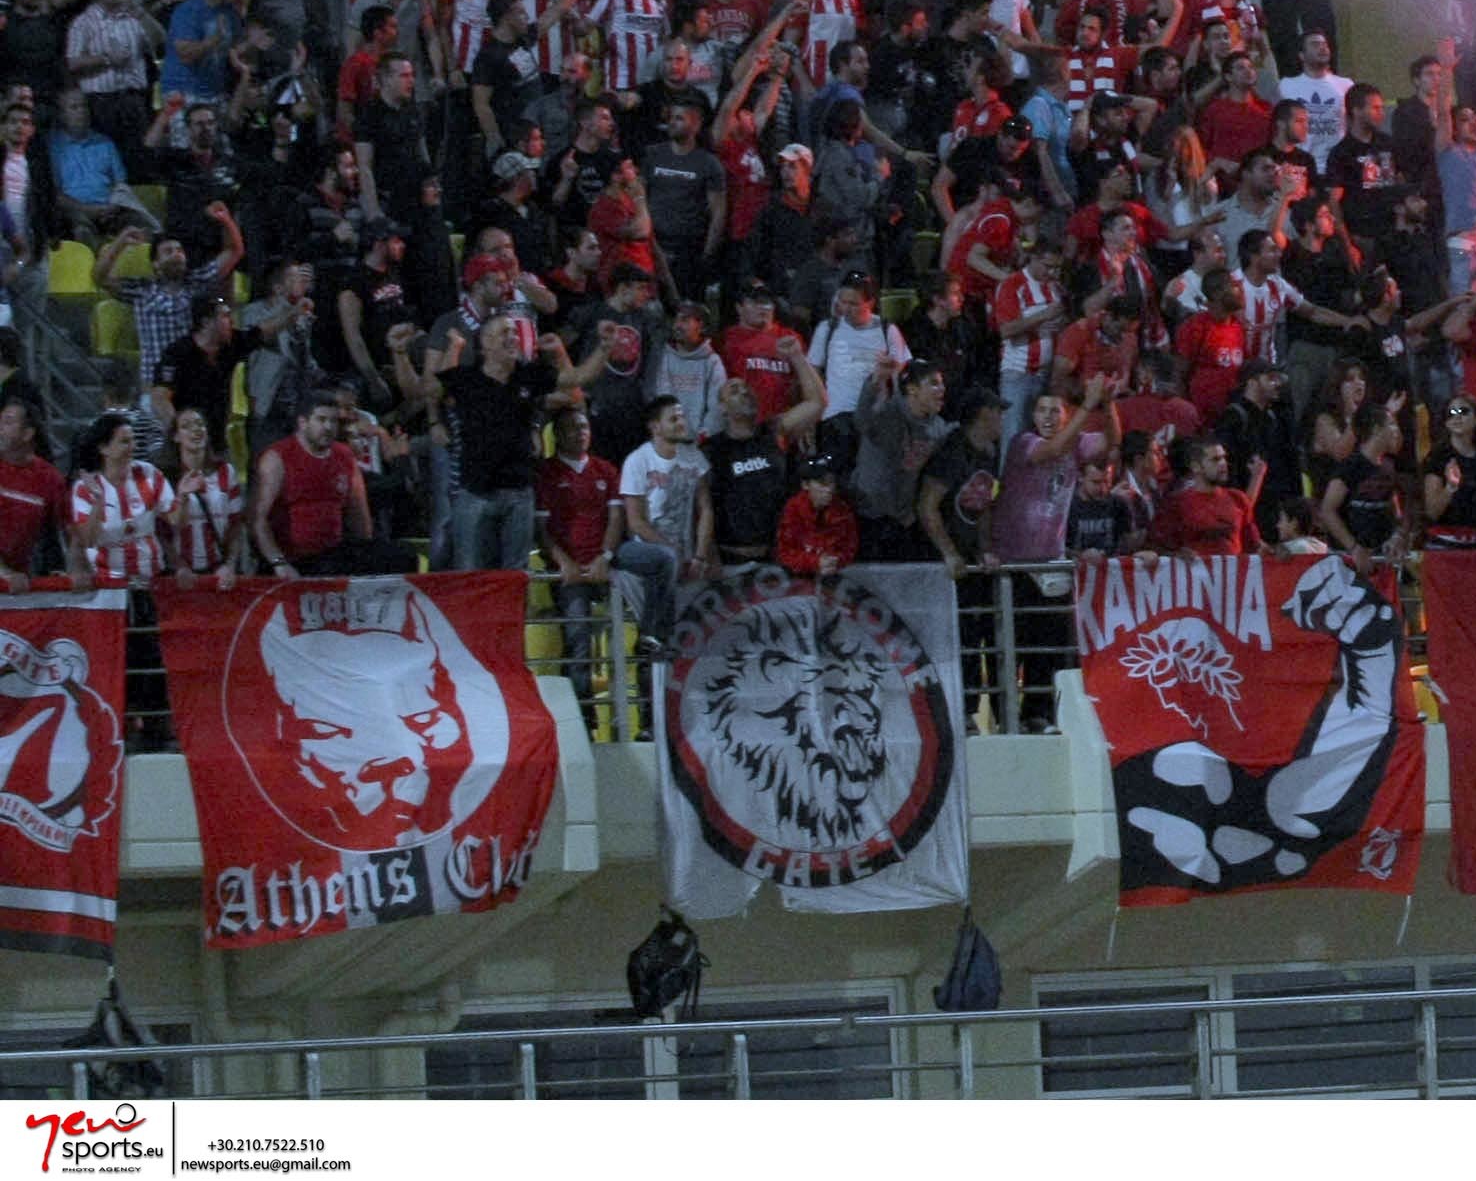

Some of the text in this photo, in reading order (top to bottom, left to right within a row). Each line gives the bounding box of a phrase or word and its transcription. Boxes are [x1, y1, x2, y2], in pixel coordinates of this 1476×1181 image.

[1076, 554, 1273, 656] KAMINIA
[3, 641, 63, 682] GATE
[744, 837, 873, 886] GATE
[216, 856, 417, 935] Athens
